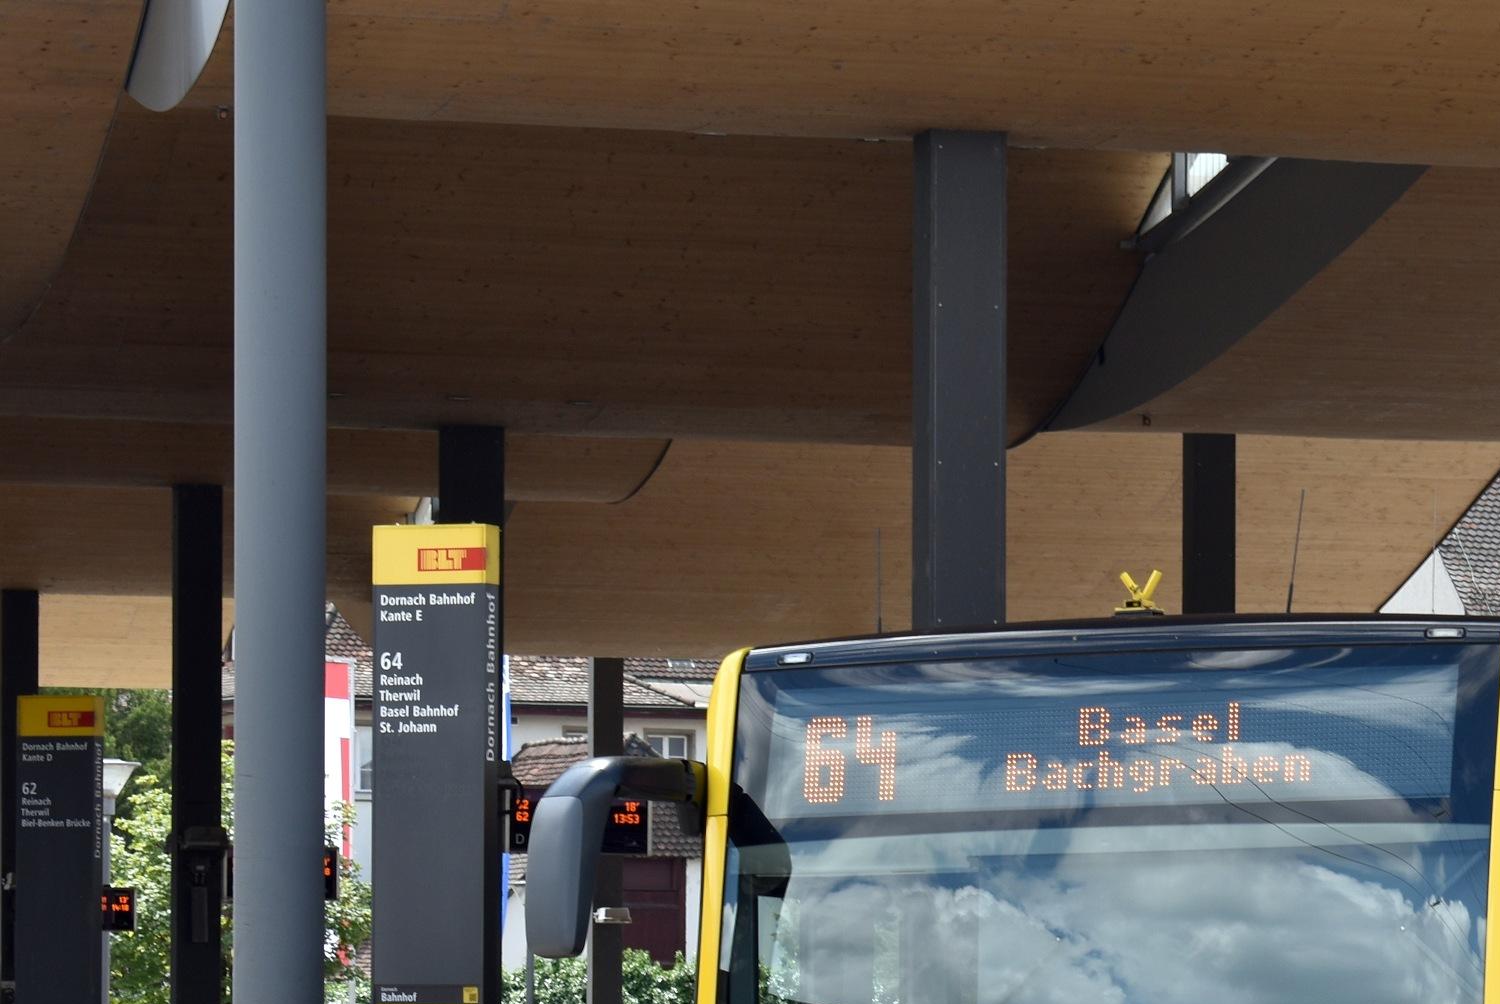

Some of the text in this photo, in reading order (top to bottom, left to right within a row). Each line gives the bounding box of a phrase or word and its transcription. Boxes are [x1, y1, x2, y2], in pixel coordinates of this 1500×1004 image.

[419, 549, 467, 571] BLT
[380, 592, 475, 606] Dornach Bahnhof
[380, 610, 423, 622] Kante E
[380, 652, 403, 670] 64
[380, 674, 423, 686] Reinach
[486, 592, 496, 762] Dornach Bahnhof
[379, 689, 421, 702] Therwil
[380, 705, 459, 718] Basel Bahnhof
[379, 721, 437, 733] St. Johann
[1079, 701, 1240, 746] Basel
[22, 742, 88, 751] Dornach Bahnhof
[22, 754, 53, 762] Kante D
[803, 716, 897, 804] 64
[1006, 746, 1311, 792] Bachgraben
[22, 782, 37, 795] 62
[22, 797, 52, 806] Reinach
[21, 808, 50, 816] Therwil
[516, 812, 529, 822] 62
[21, 819, 91, 828] Biel-Benken Brücke
[613, 813, 640, 824] 13:53
[515, 833, 525, 845] D
[381, 992, 418, 1002] Bahnhof
